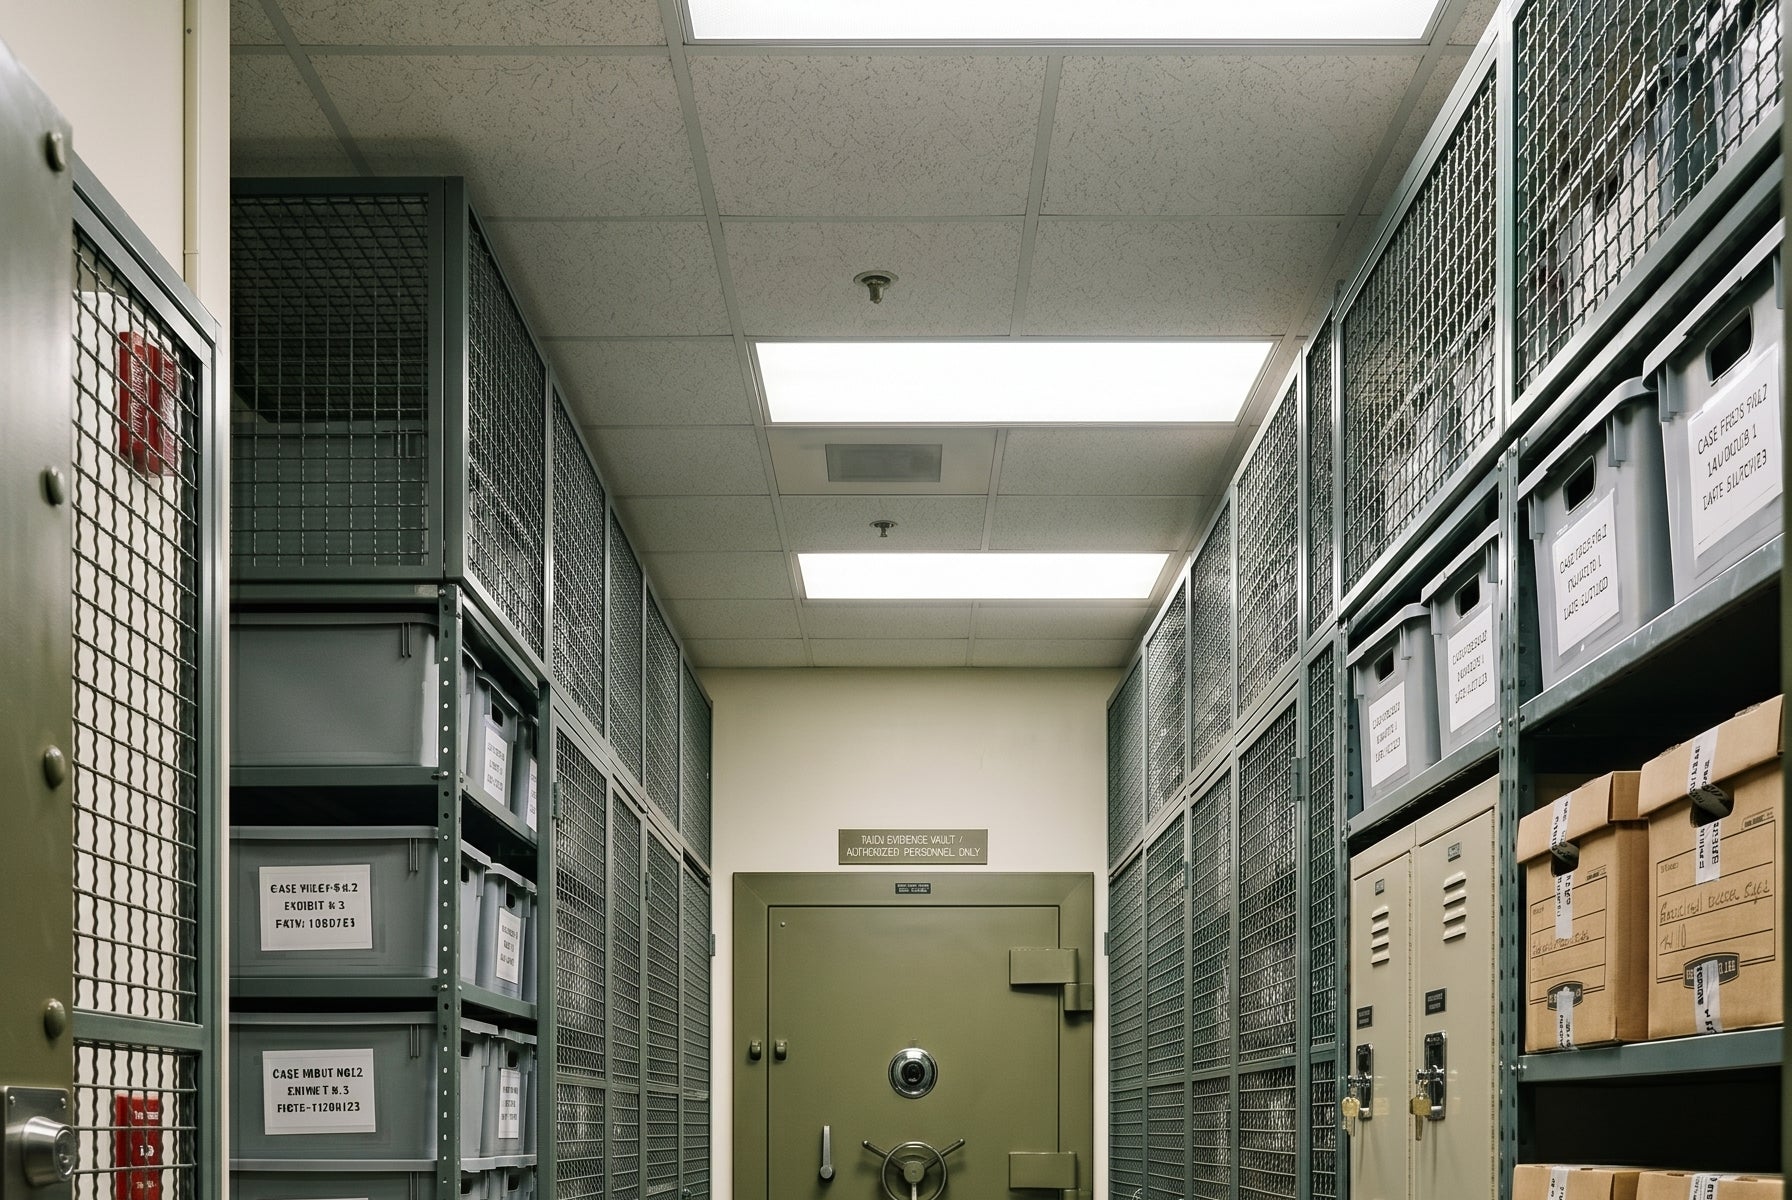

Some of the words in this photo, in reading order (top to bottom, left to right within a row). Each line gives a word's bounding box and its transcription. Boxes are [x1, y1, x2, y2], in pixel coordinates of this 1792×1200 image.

[930, 835, 956, 844] VAULT
[903, 847, 955, 857] PERSONNEL
[958, 847, 981, 857] ONLY
[272, 1068, 299, 1080] CASE
